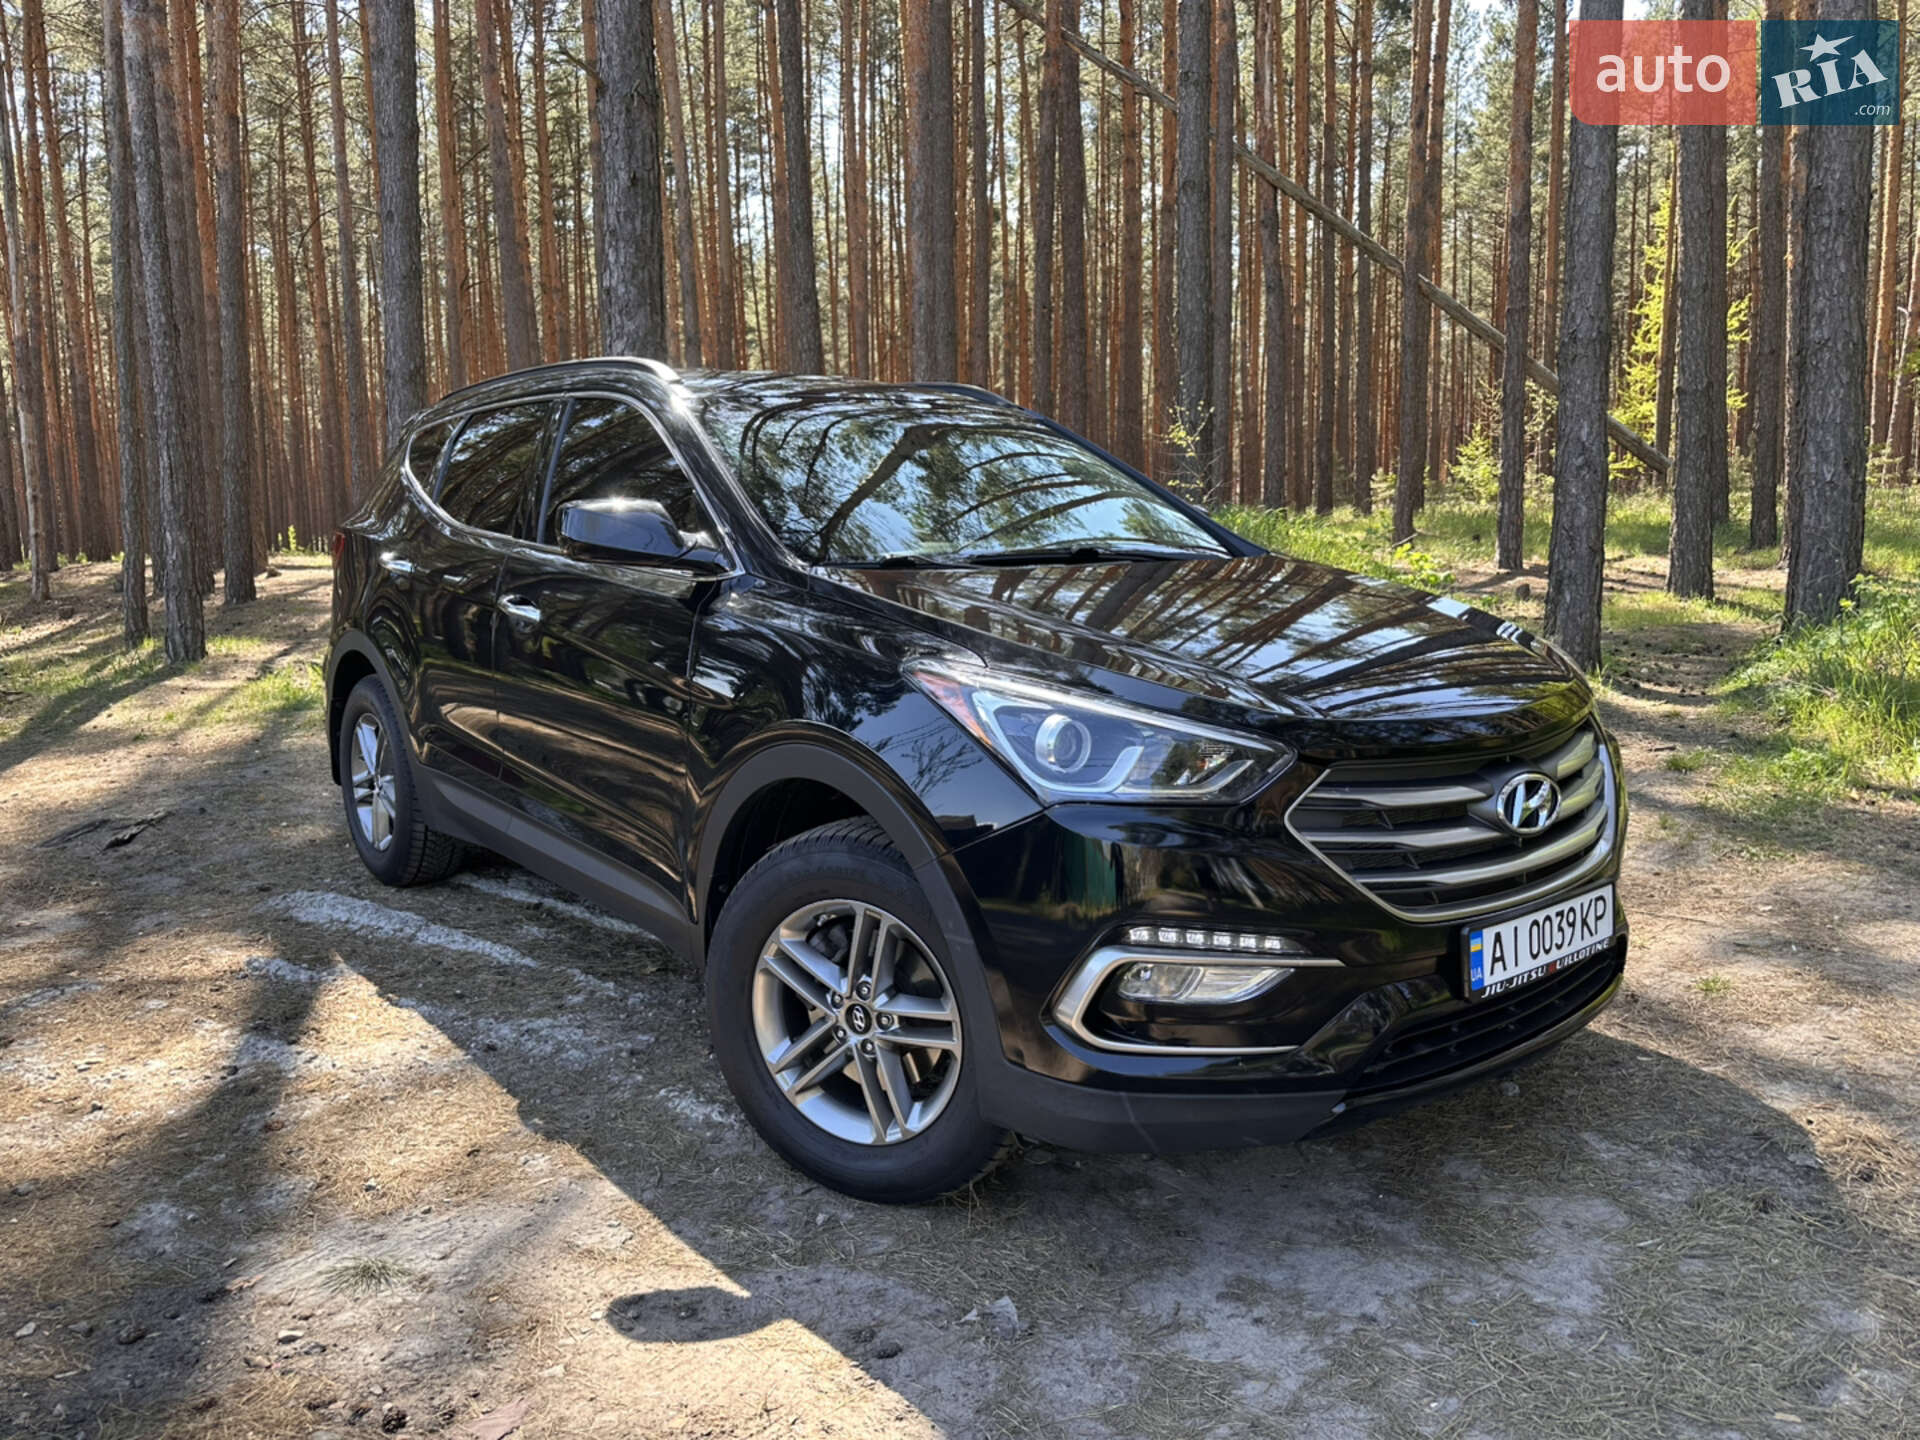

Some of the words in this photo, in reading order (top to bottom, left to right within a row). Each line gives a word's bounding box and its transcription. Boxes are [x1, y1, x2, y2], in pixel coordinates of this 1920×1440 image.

[1490, 926, 1518, 976] AI
[1529, 906, 1577, 960] 0039
[1581, 895, 1608, 942] KP
[1470, 967, 1483, 981] UA
[1481, 965, 1546, 998] JIU-JITSU
